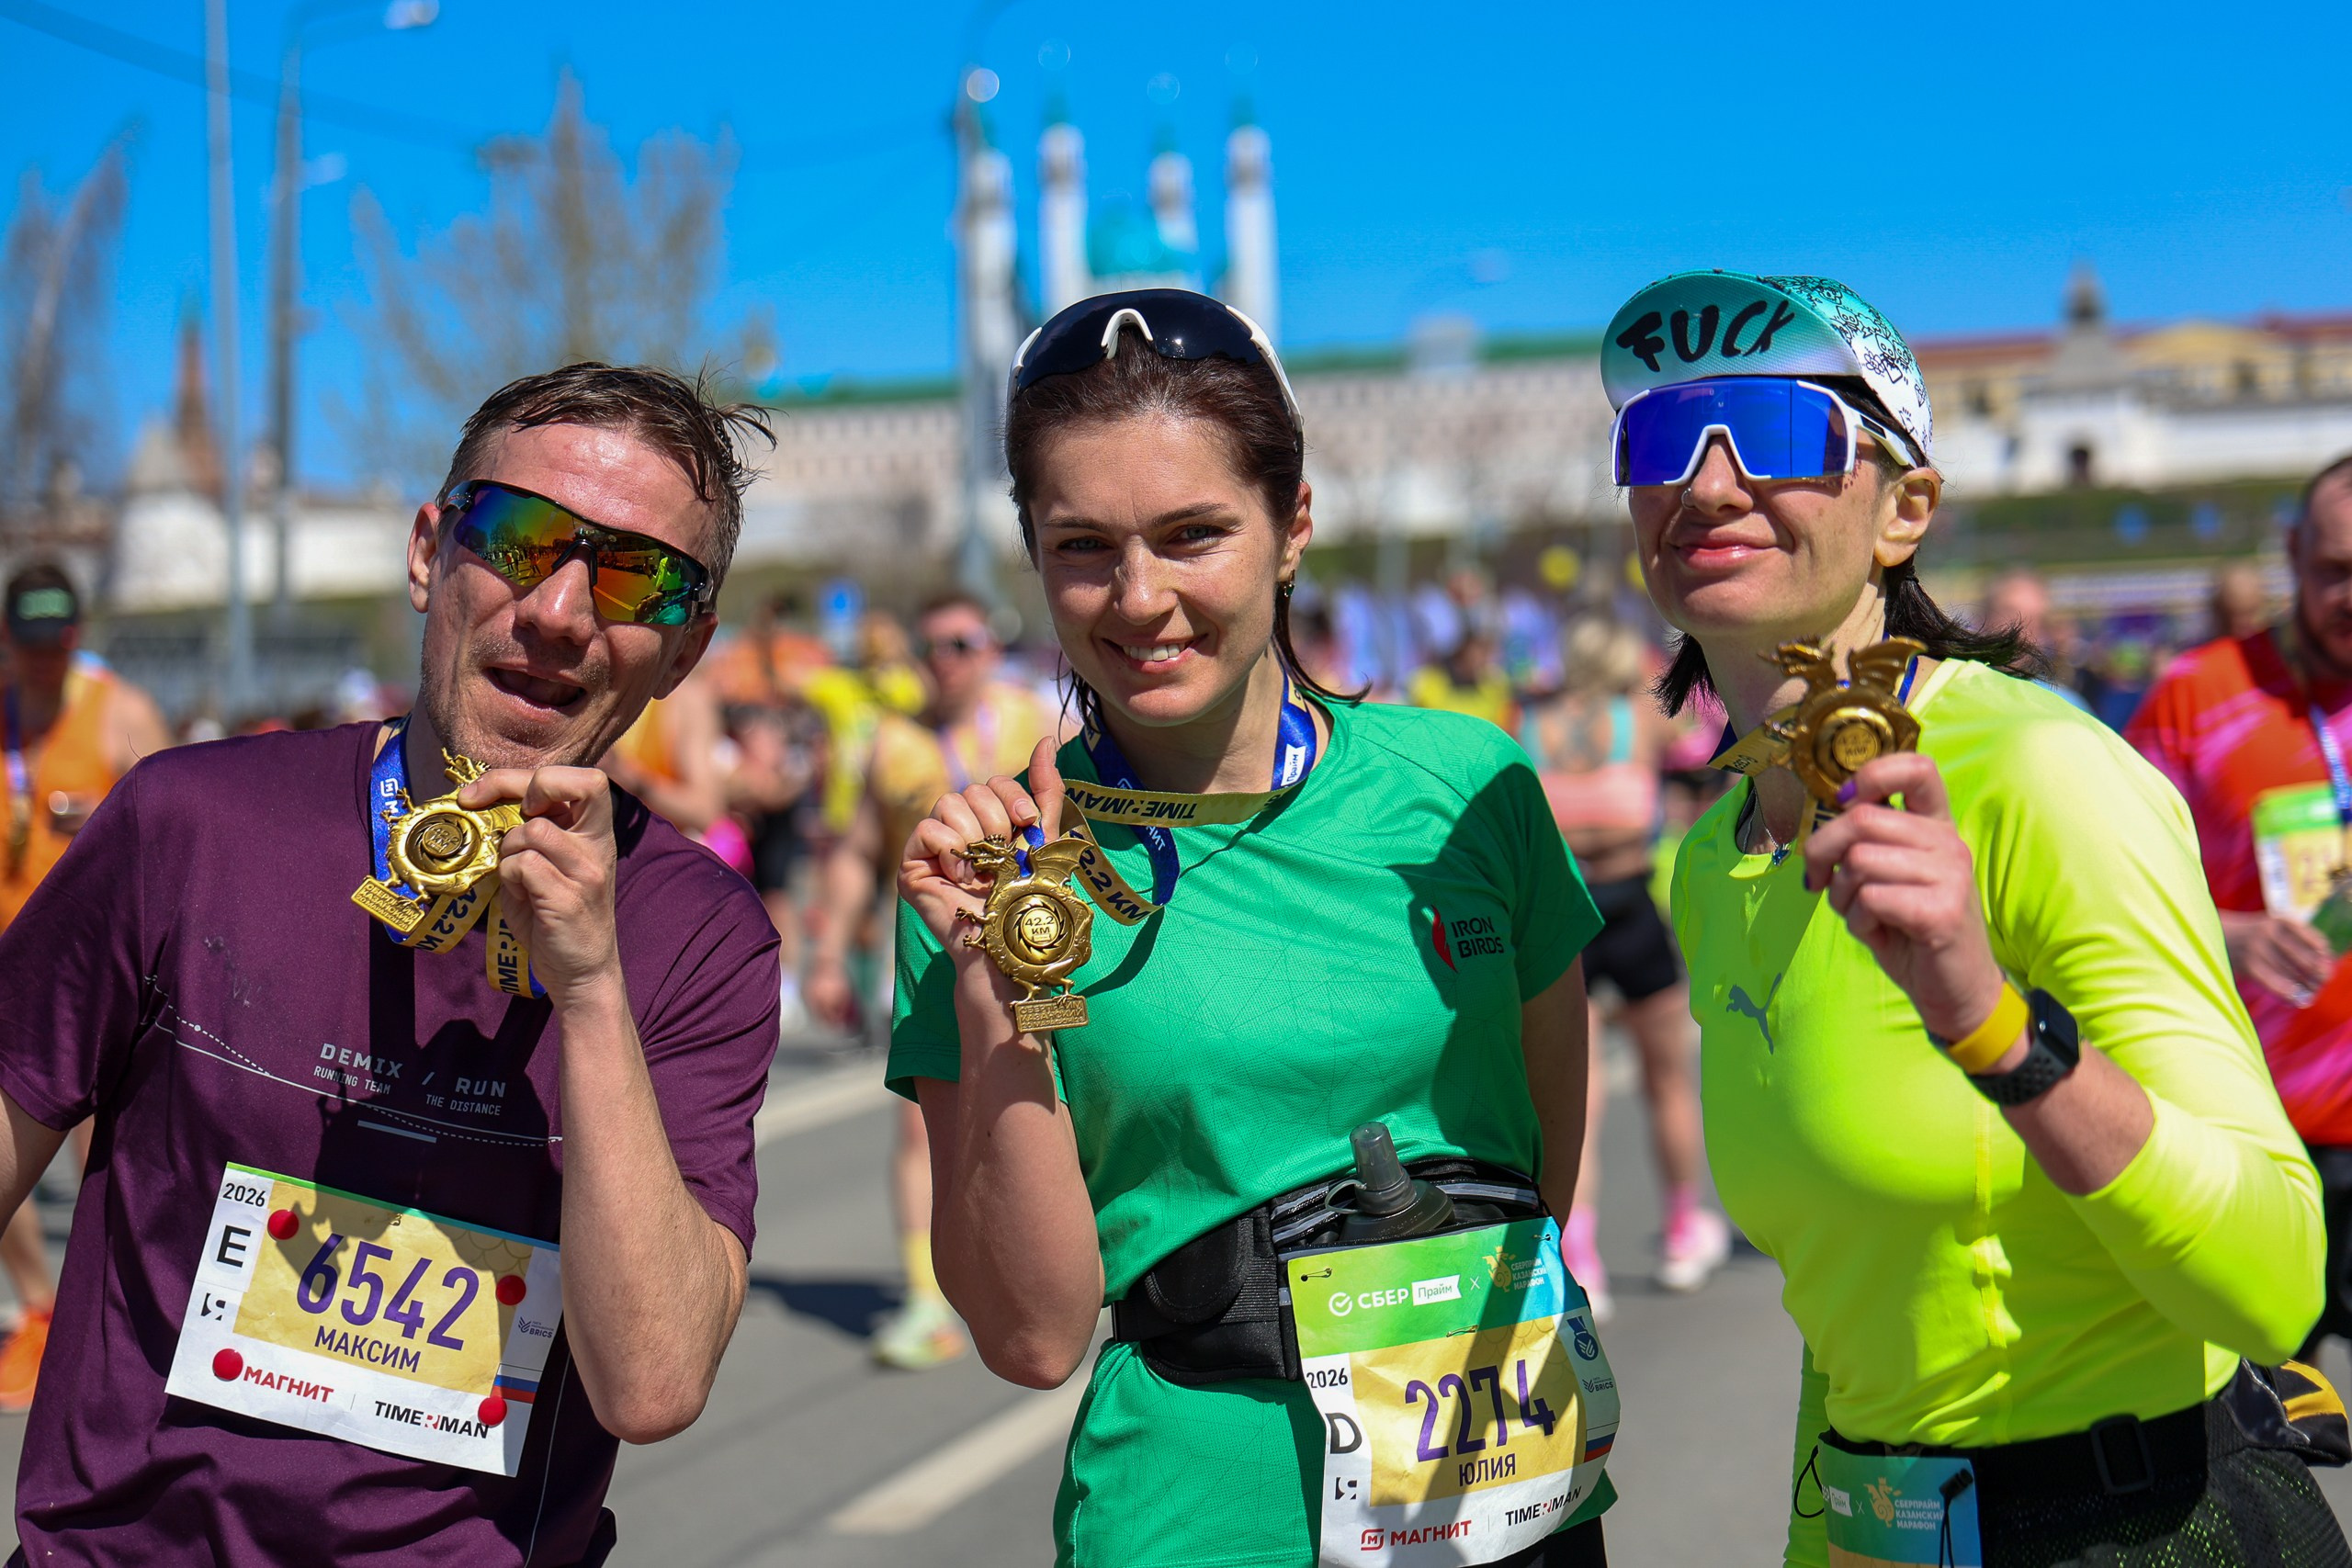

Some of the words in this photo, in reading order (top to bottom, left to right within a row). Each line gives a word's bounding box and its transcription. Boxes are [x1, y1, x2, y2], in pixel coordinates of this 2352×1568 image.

[1616, 299, 1795, 372] FUCK
[1025, 916, 1055, 927] 42.2
[1451, 916, 1496, 939] IRON
[1457, 937, 1505, 959] BIRDS
[313, 1066, 358, 1087] RUNNING
[365, 1078, 390, 1095] TEAM
[320, 1043, 403, 1079] DEMIX
[456, 1077, 506, 1098] RUN
[425, 1094, 444, 1108] THE
[449, 1100, 502, 1116] DISTANCE
[222, 1183, 266, 1207] 2026
[296, 1233, 480, 1351] 6542
[1358, 1289, 1408, 1310] СБЕР
[1418, 1283, 1453, 1301] Прайм
[528, 1328, 553, 1338] BRICS
[314, 1325, 422, 1373] МАКСИМ
[243, 1366, 334, 1404] МАГНИТ
[1306, 1368, 1349, 1389] 2026
[1594, 1381, 1614, 1392] BRICS
[1405, 1359, 1556, 1462] 2274
[1325, 1412, 1363, 1454] D
[1459, 1453, 1516, 1488] ЮЛИЯ
[1894, 1498, 1940, 1509] СБЕРПРАЙМ
[1895, 1509, 1945, 1520] КАЗАНСКИЙ
[1390, 1520, 1472, 1546] МАГНИТ
[1896, 1520, 1937, 1531] МАРАФОН
